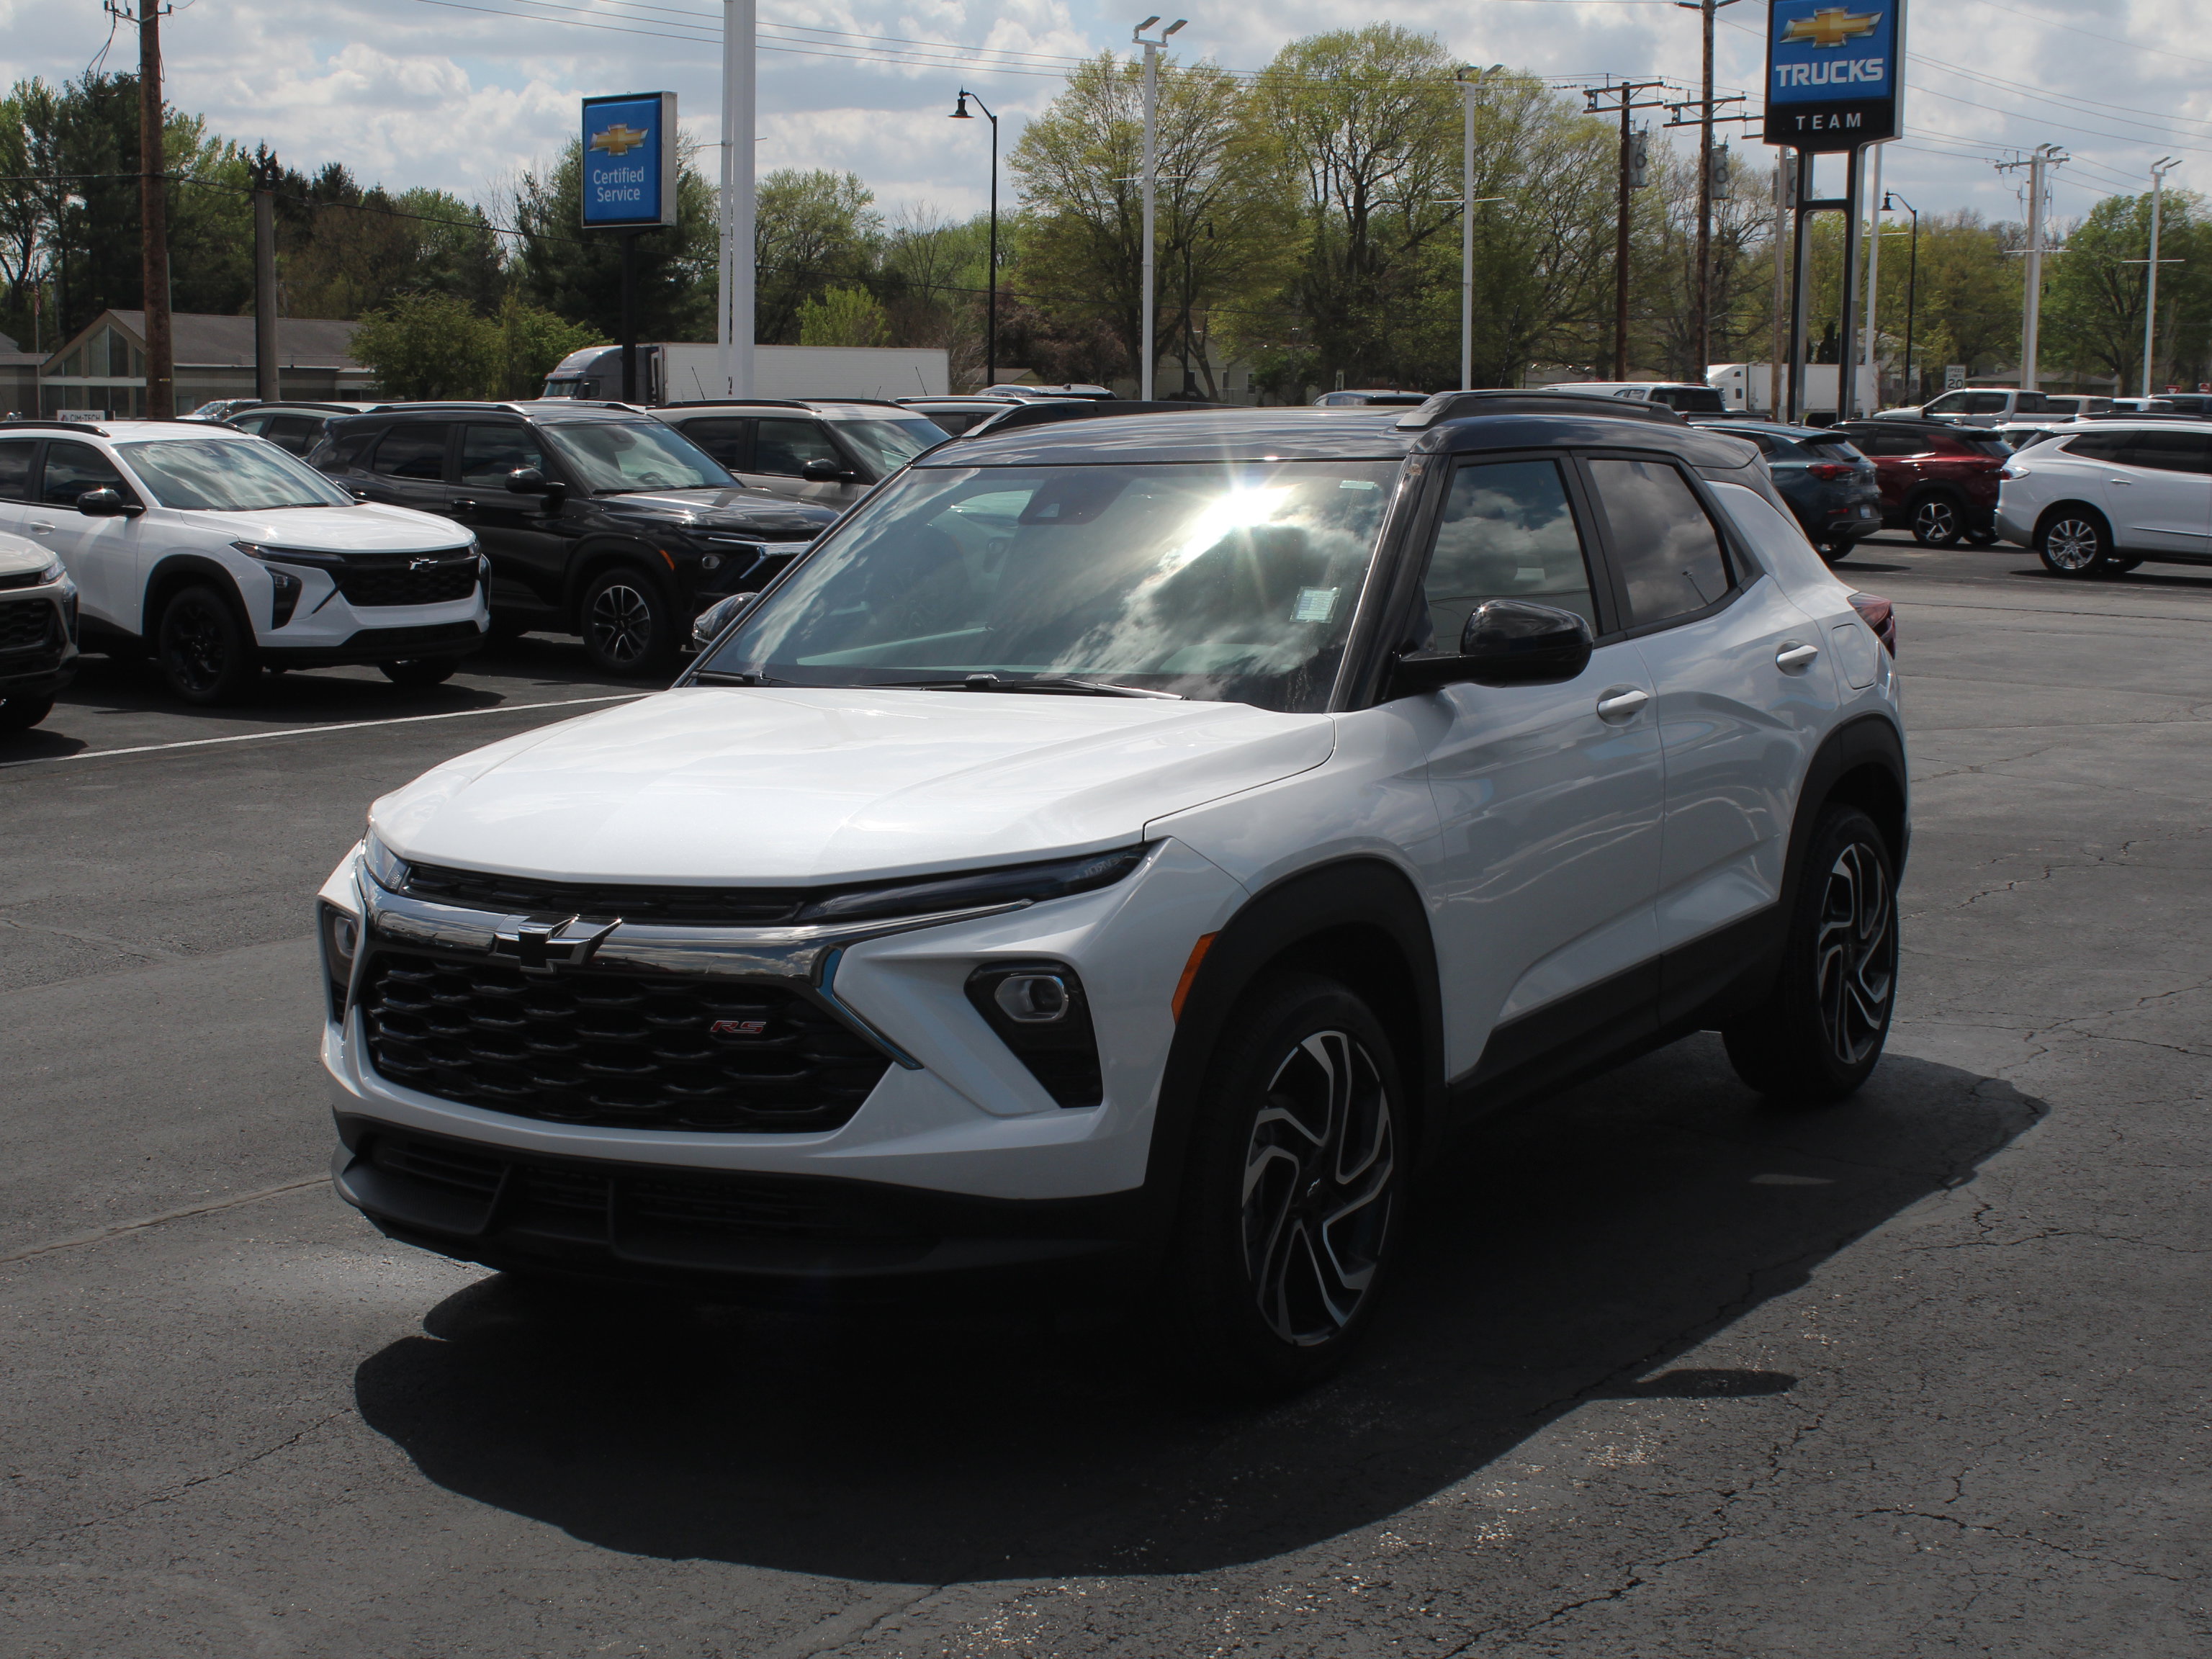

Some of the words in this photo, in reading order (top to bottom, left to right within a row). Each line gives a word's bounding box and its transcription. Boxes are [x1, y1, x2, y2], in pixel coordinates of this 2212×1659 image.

[1775, 58, 1884, 87] TRUCKS
[1795, 112, 1861, 130] TEAM
[593, 166, 644, 185] Certified
[597, 186, 641, 202] Service
[1947, 379, 1964, 388] 20
[710, 1020, 766, 1034] RS
